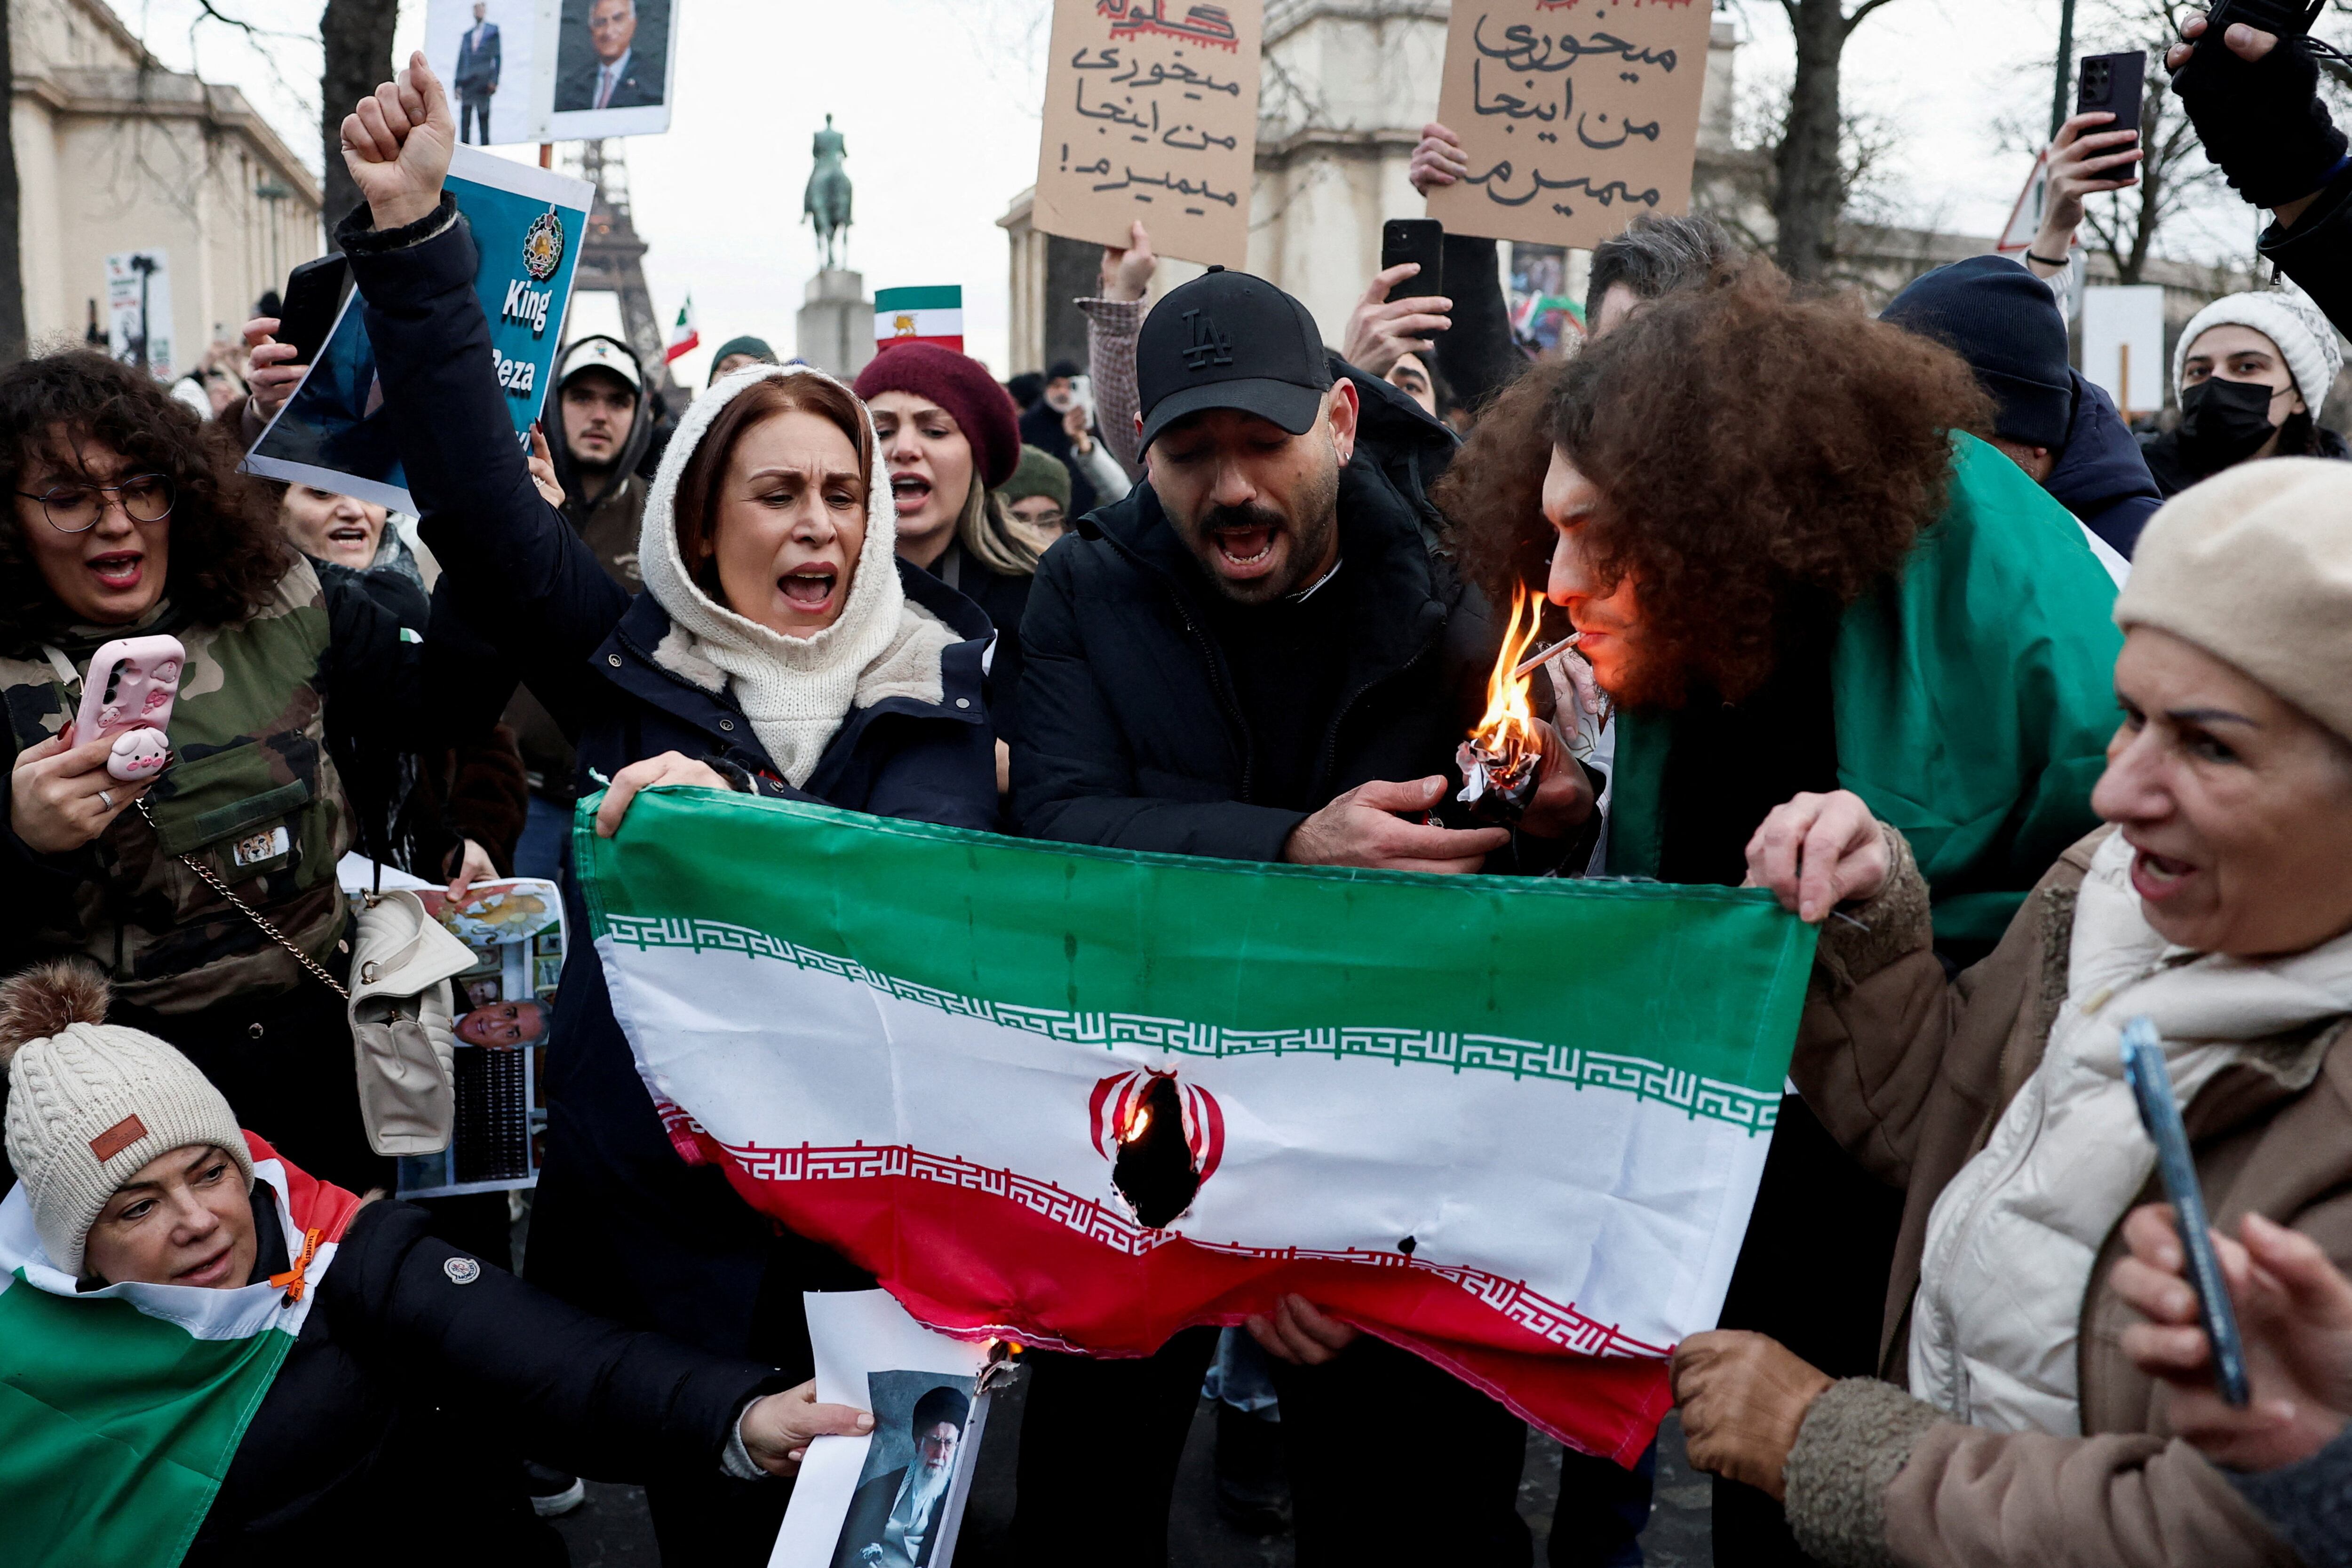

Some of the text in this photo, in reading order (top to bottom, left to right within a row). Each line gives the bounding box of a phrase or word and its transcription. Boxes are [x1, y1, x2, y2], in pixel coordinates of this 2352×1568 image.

[1076, 78, 1236, 150] من اینجا
[1474, 58, 1660, 150] من اینجا
[502, 278, 553, 332] King
[1182, 309, 1233, 369] LA
